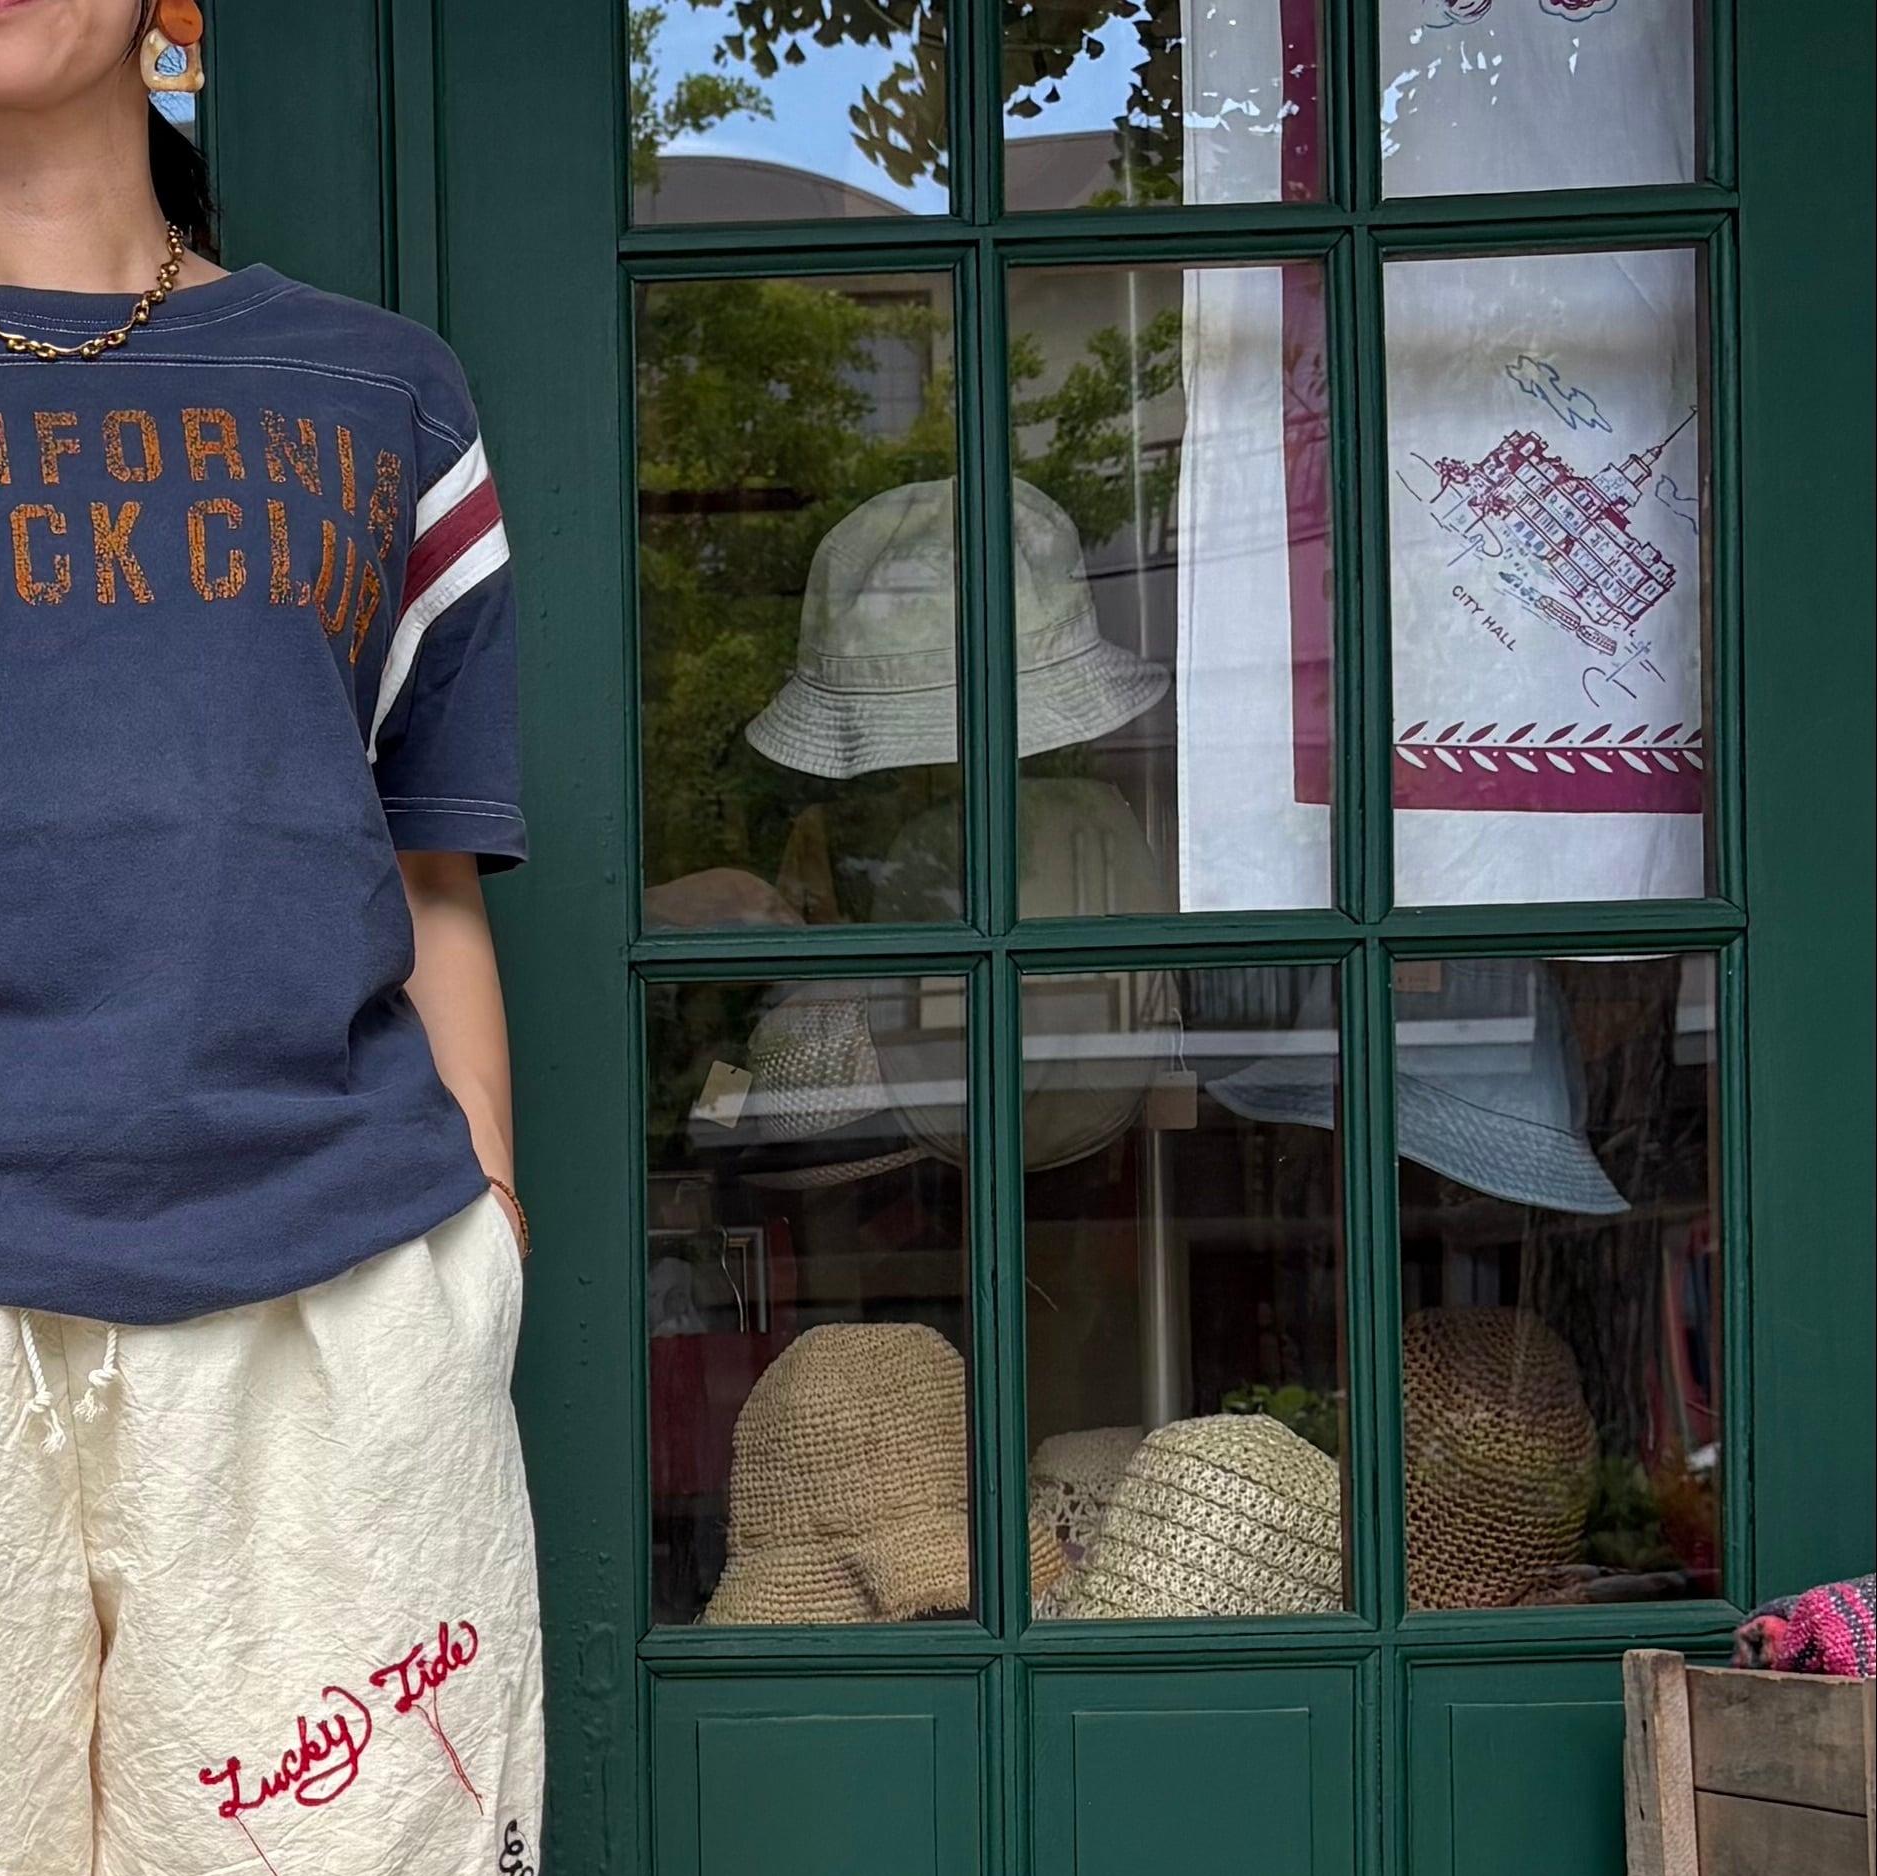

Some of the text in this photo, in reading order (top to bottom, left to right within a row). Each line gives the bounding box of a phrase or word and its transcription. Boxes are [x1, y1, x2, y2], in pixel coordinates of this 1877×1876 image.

[1451, 585, 1517, 652] CITY HALL
[198, 1685, 373, 1819] Lucky
